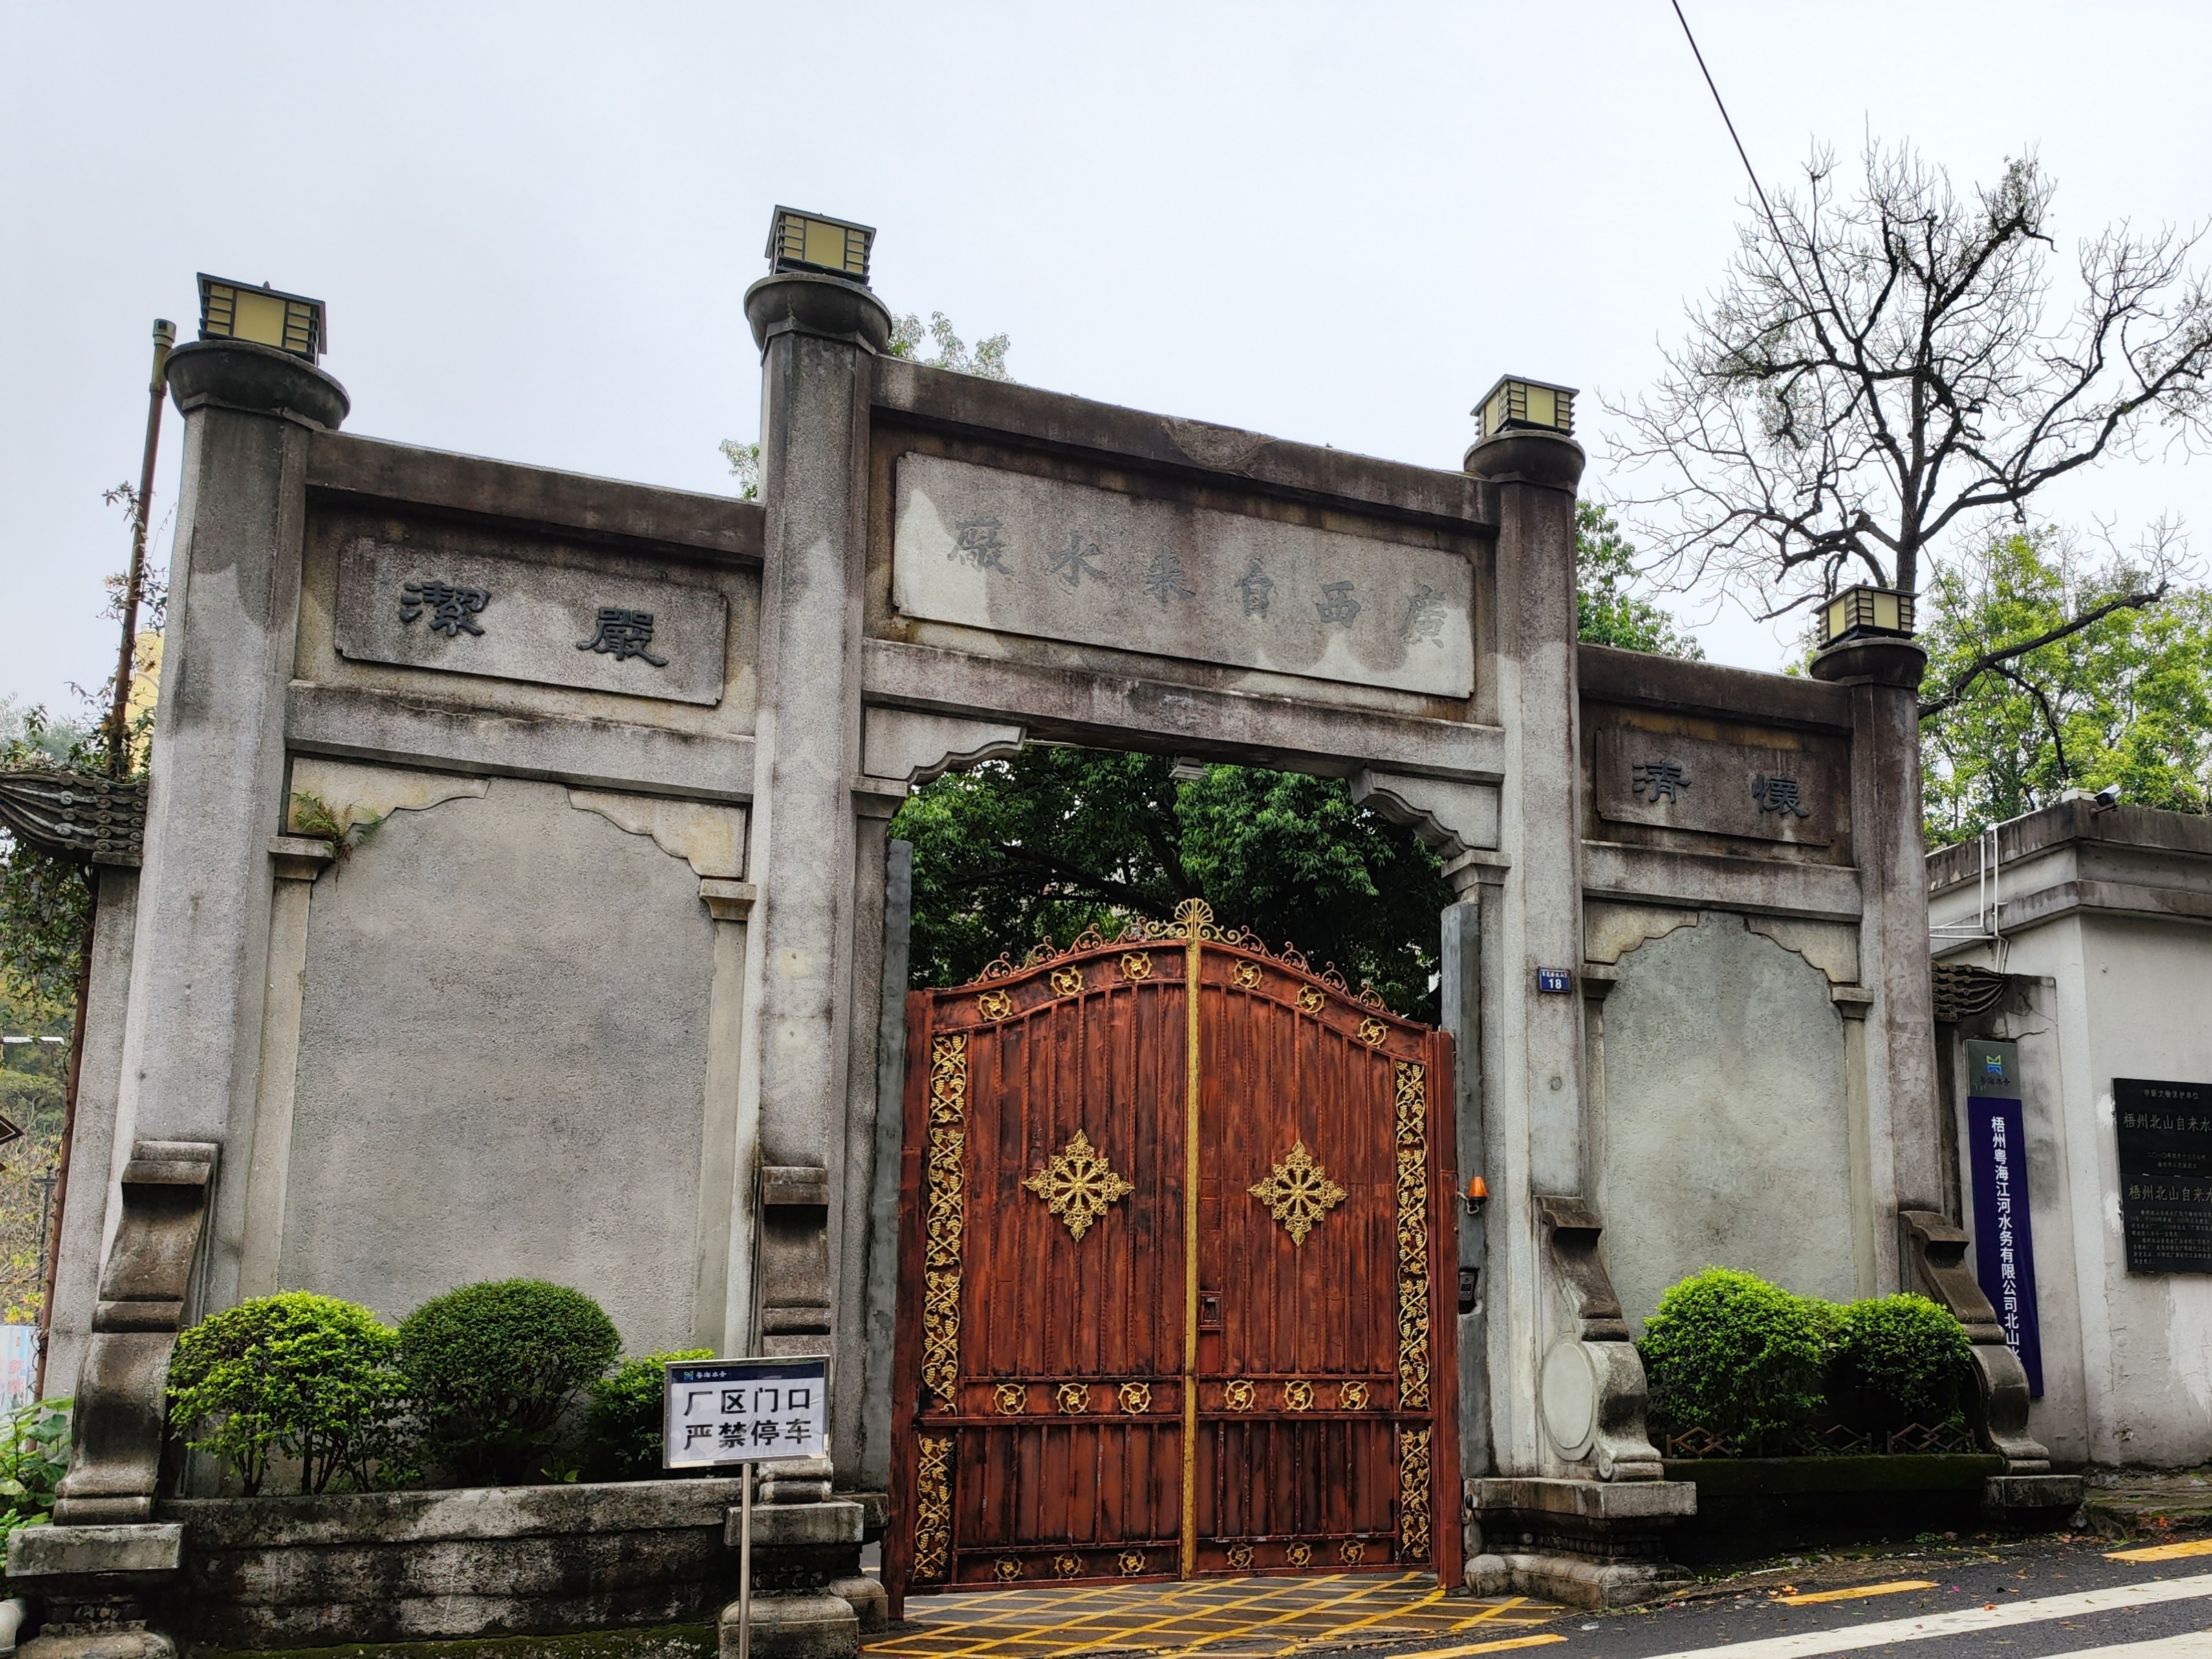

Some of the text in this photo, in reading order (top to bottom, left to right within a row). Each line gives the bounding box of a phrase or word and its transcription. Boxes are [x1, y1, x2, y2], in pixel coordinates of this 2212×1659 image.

[1548, 979, 1561, 989] 18
[2123, 1112, 2212, 1132] 梧州北山自来水
[684, 1387, 810, 1416] 厂区门口
[684, 1419, 811, 1450] 严禁停车
